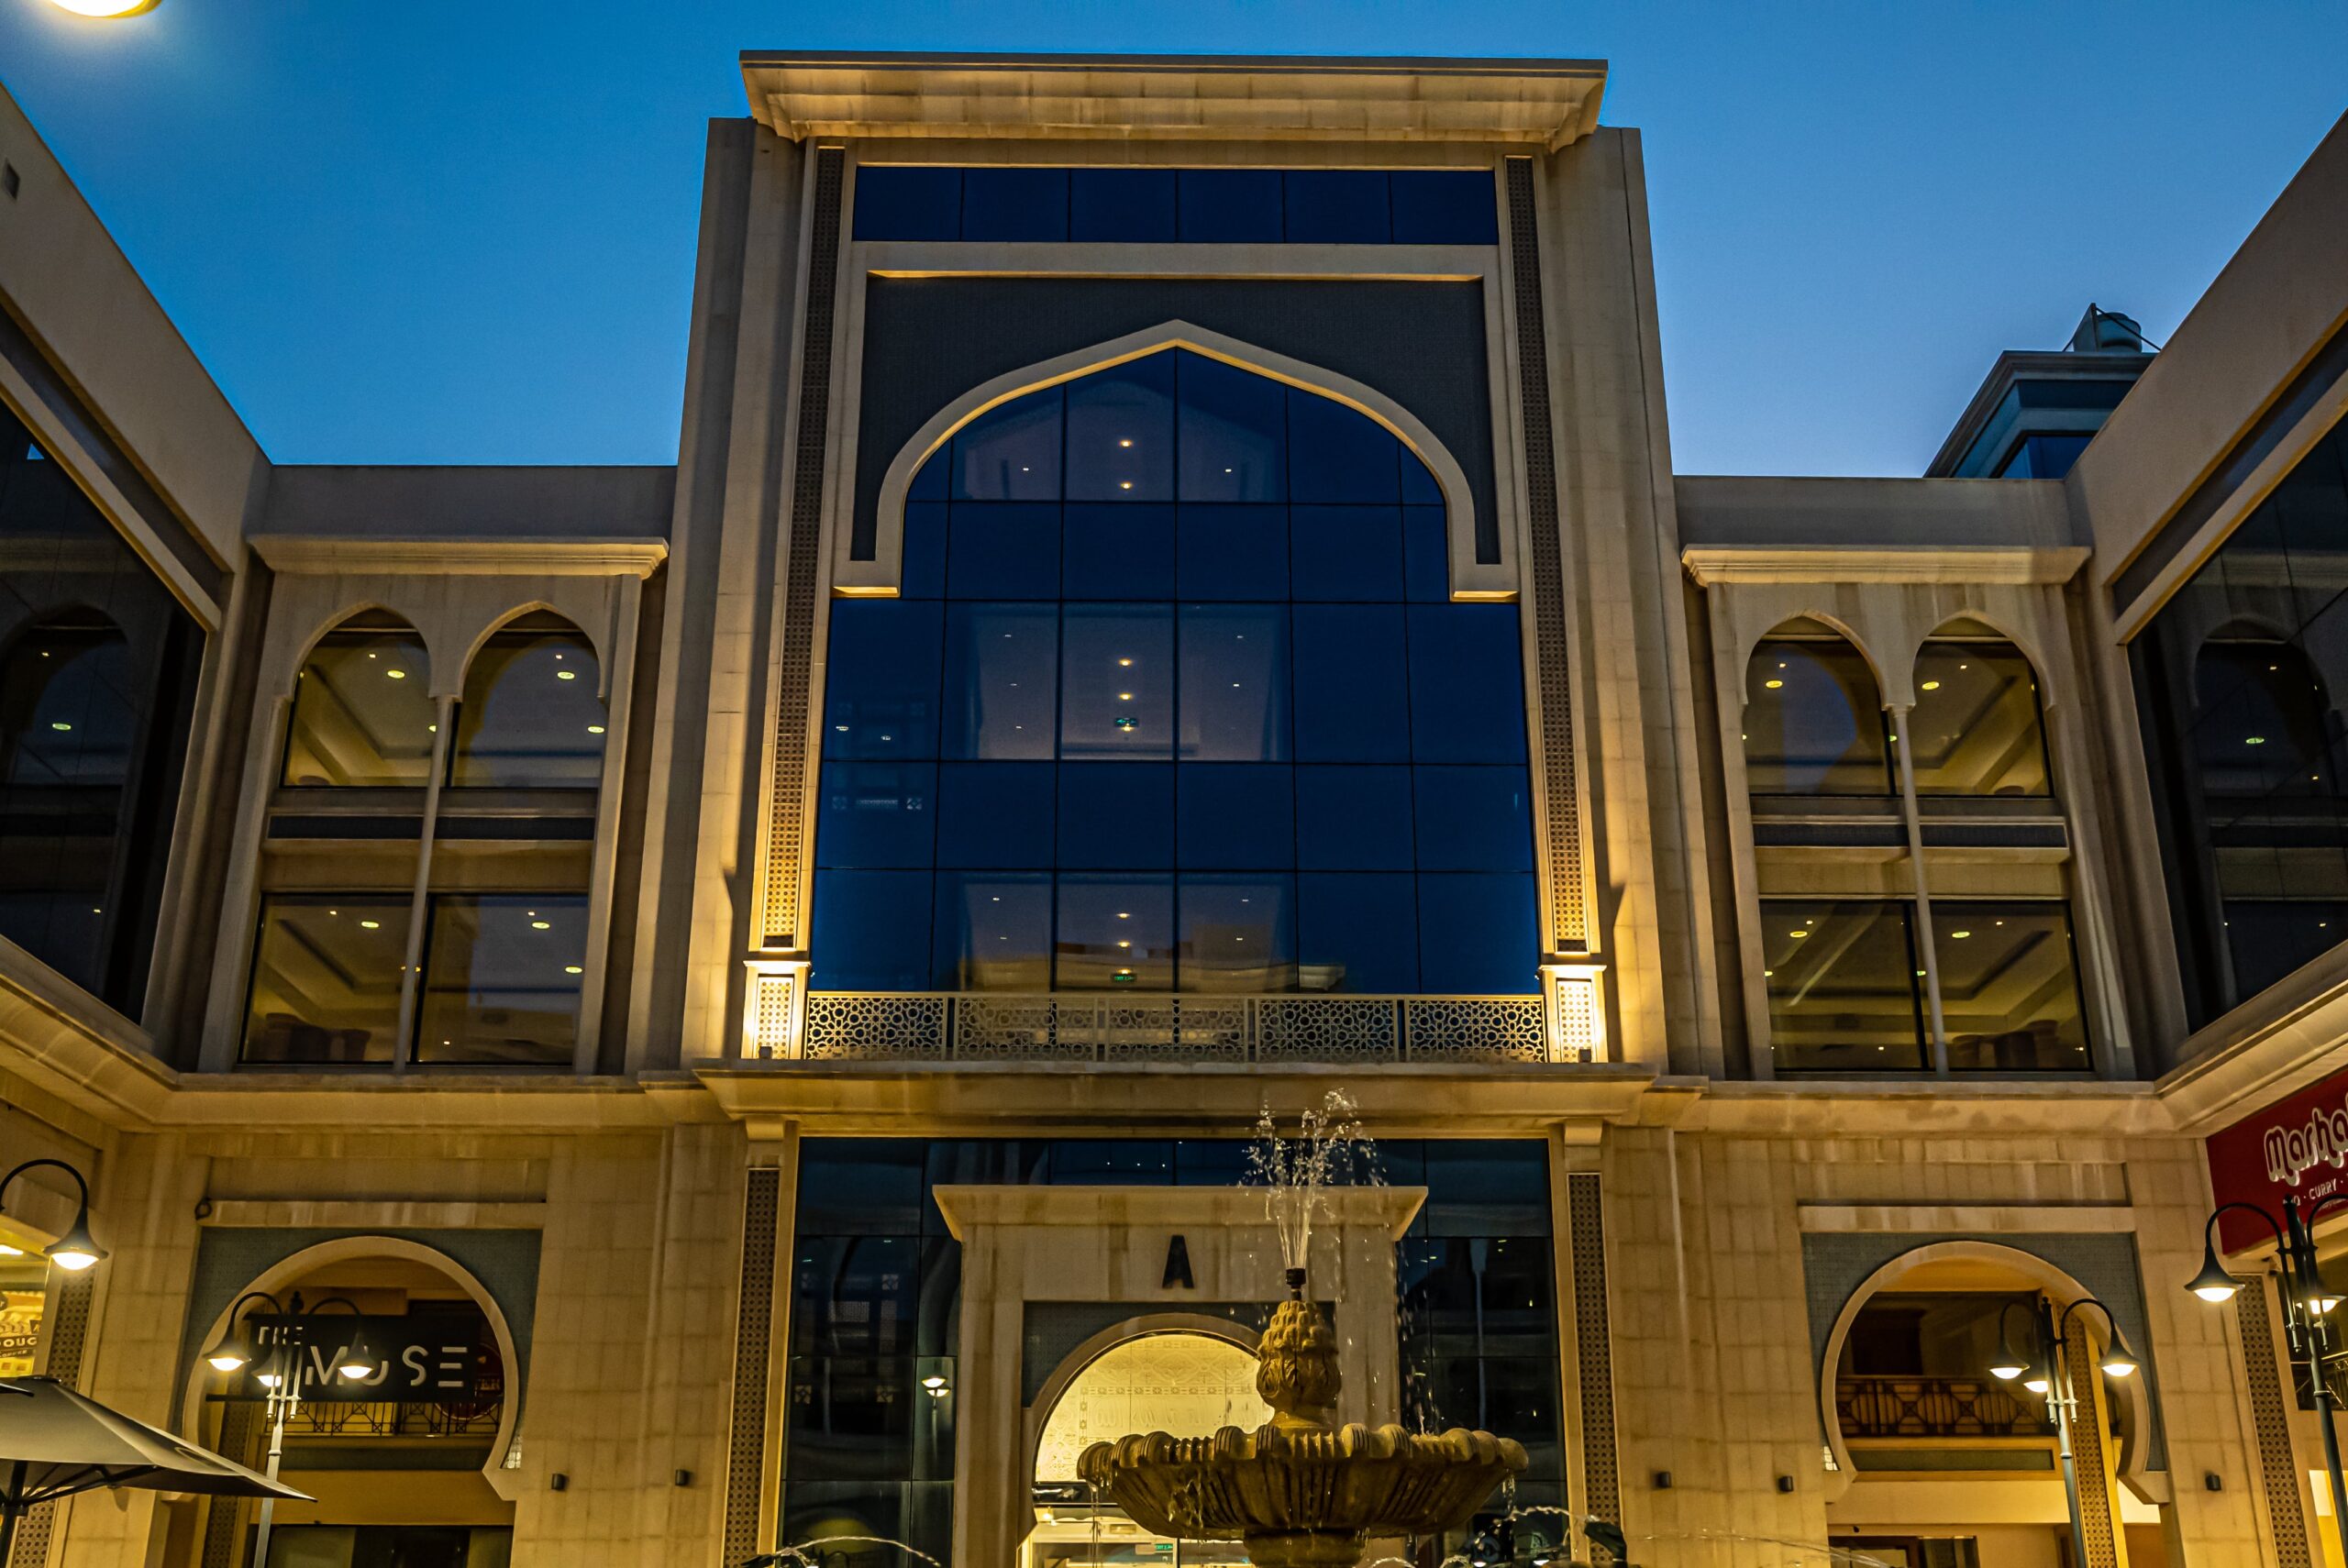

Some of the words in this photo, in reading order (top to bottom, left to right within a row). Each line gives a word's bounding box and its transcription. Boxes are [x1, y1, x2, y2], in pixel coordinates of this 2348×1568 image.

[2264, 1092, 2348, 1187] Marha
[2309, 1177, 2337, 1200] CURRY
[1162, 1234, 1195, 1289] A
[258, 1326, 304, 1345] THE
[305, 1344, 468, 1387] MUSE
